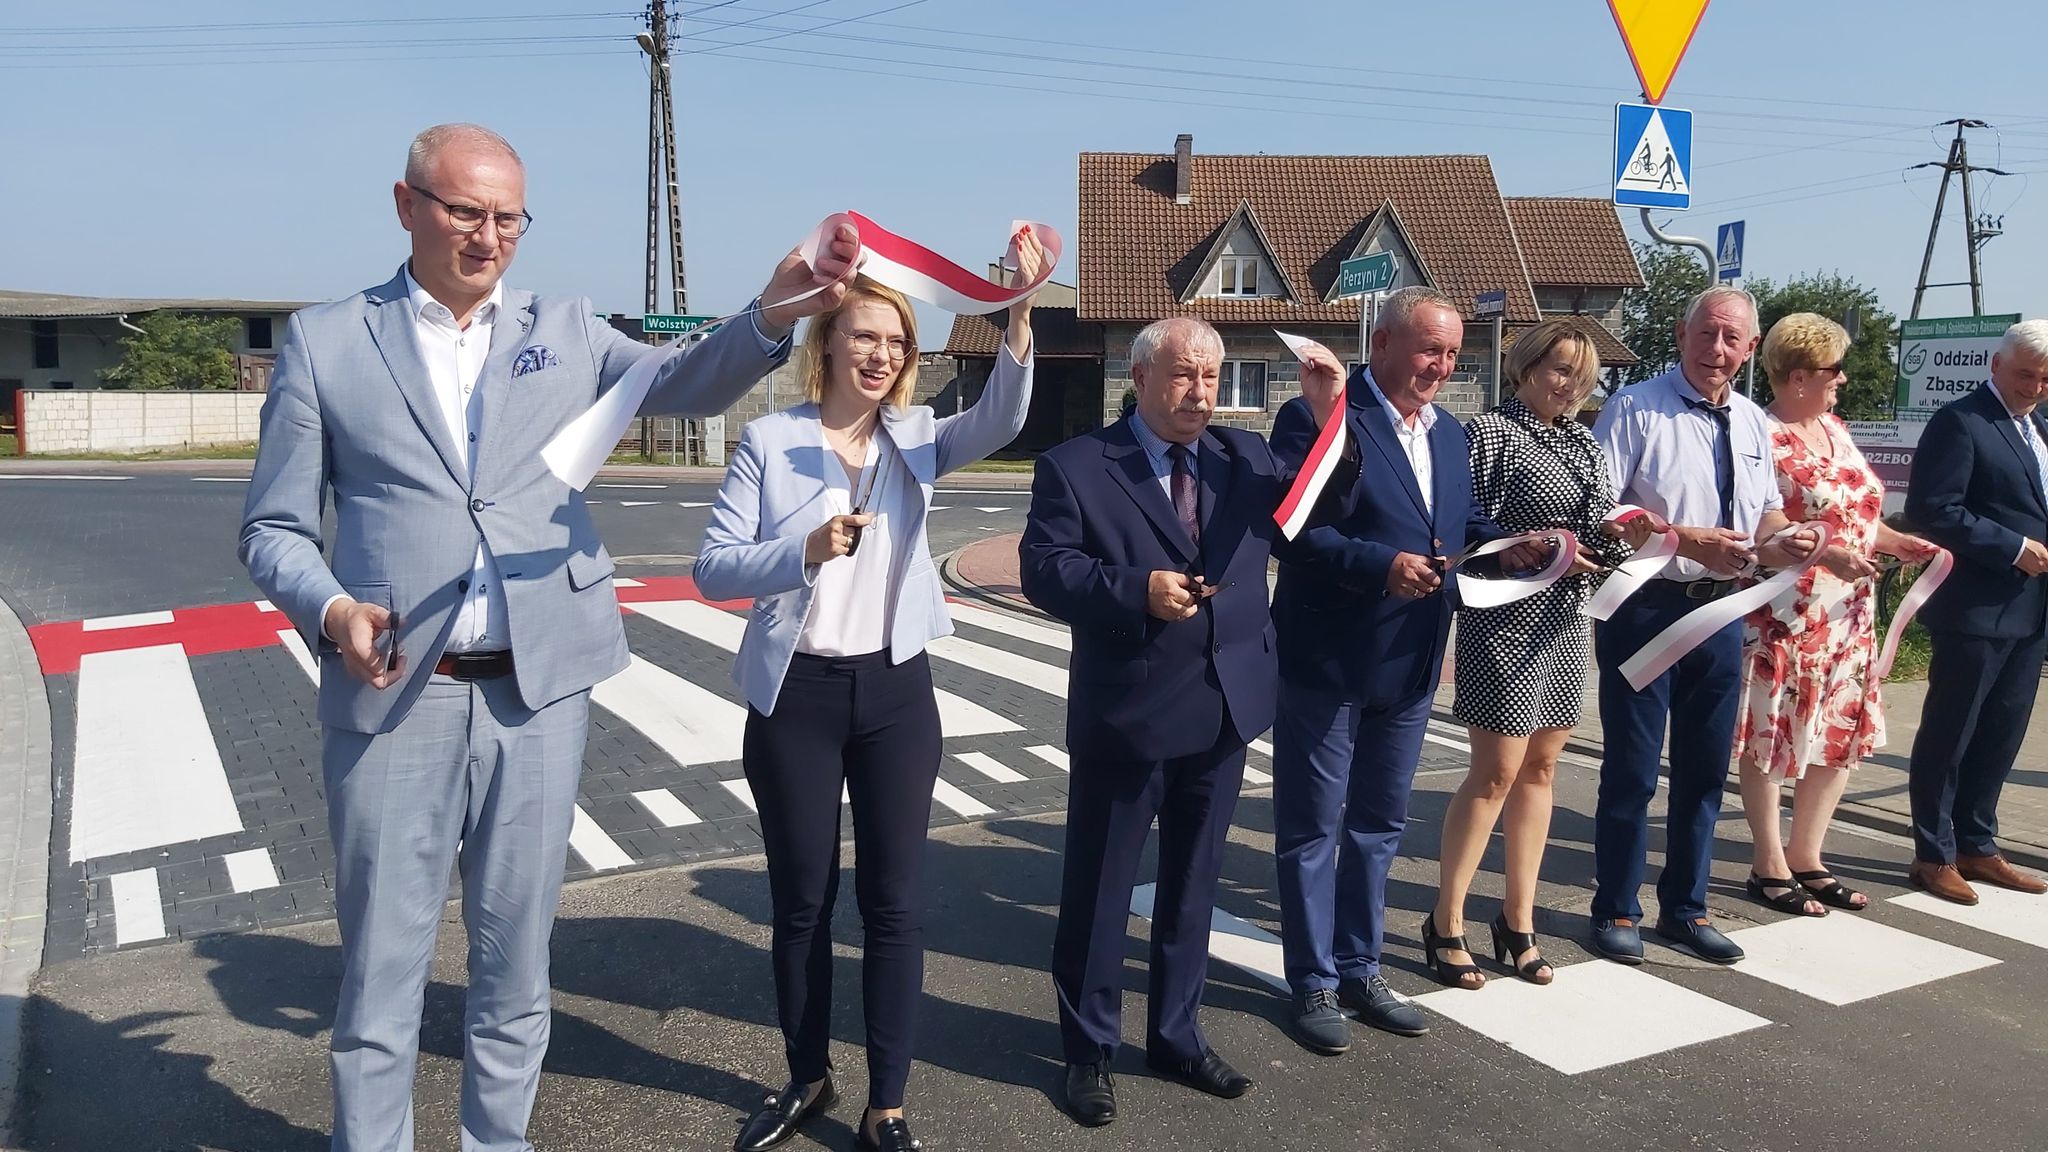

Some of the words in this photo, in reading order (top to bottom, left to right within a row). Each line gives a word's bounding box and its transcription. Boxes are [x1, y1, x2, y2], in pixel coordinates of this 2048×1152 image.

[1343, 269, 1377, 290] Perzyny
[1380, 261, 1387, 281] 2
[648, 318, 698, 331] Wolsztyn
[1908, 354, 1921, 365] SGB
[1934, 350, 1988, 366] Oddział
